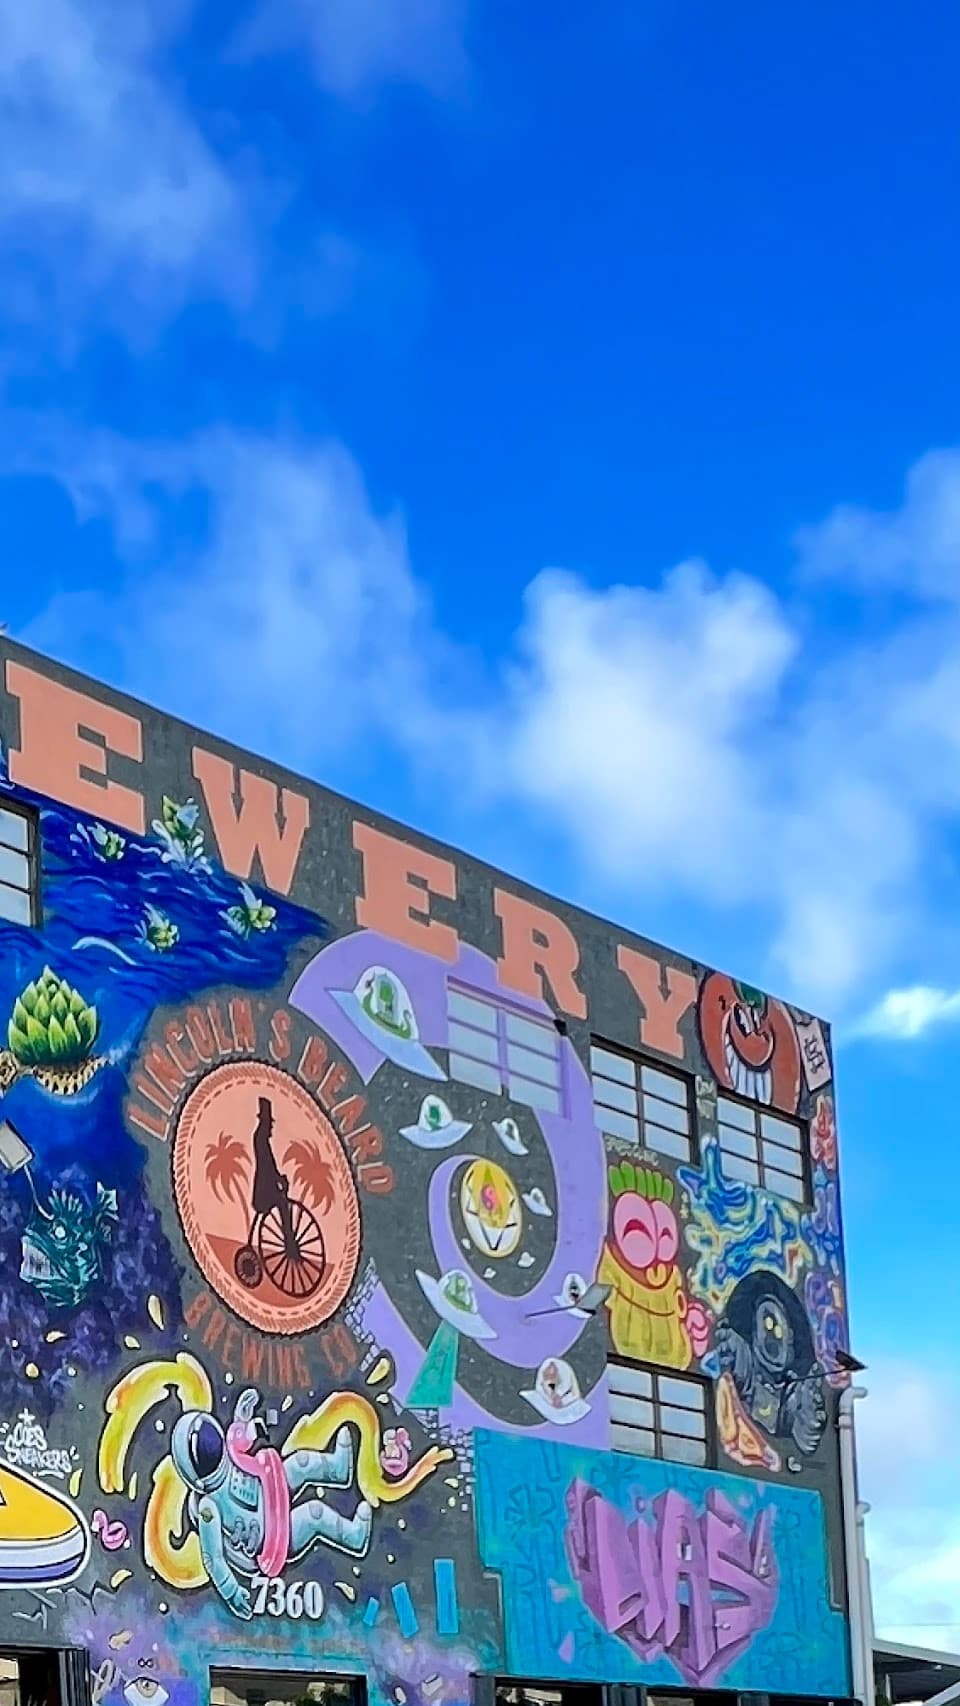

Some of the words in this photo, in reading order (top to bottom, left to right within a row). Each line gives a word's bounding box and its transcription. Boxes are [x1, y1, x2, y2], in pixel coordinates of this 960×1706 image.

[297, 1035, 395, 1194] BEARD
[183, 1290, 312, 1390] BREWING
[250, 1576, 324, 1619] 7360
